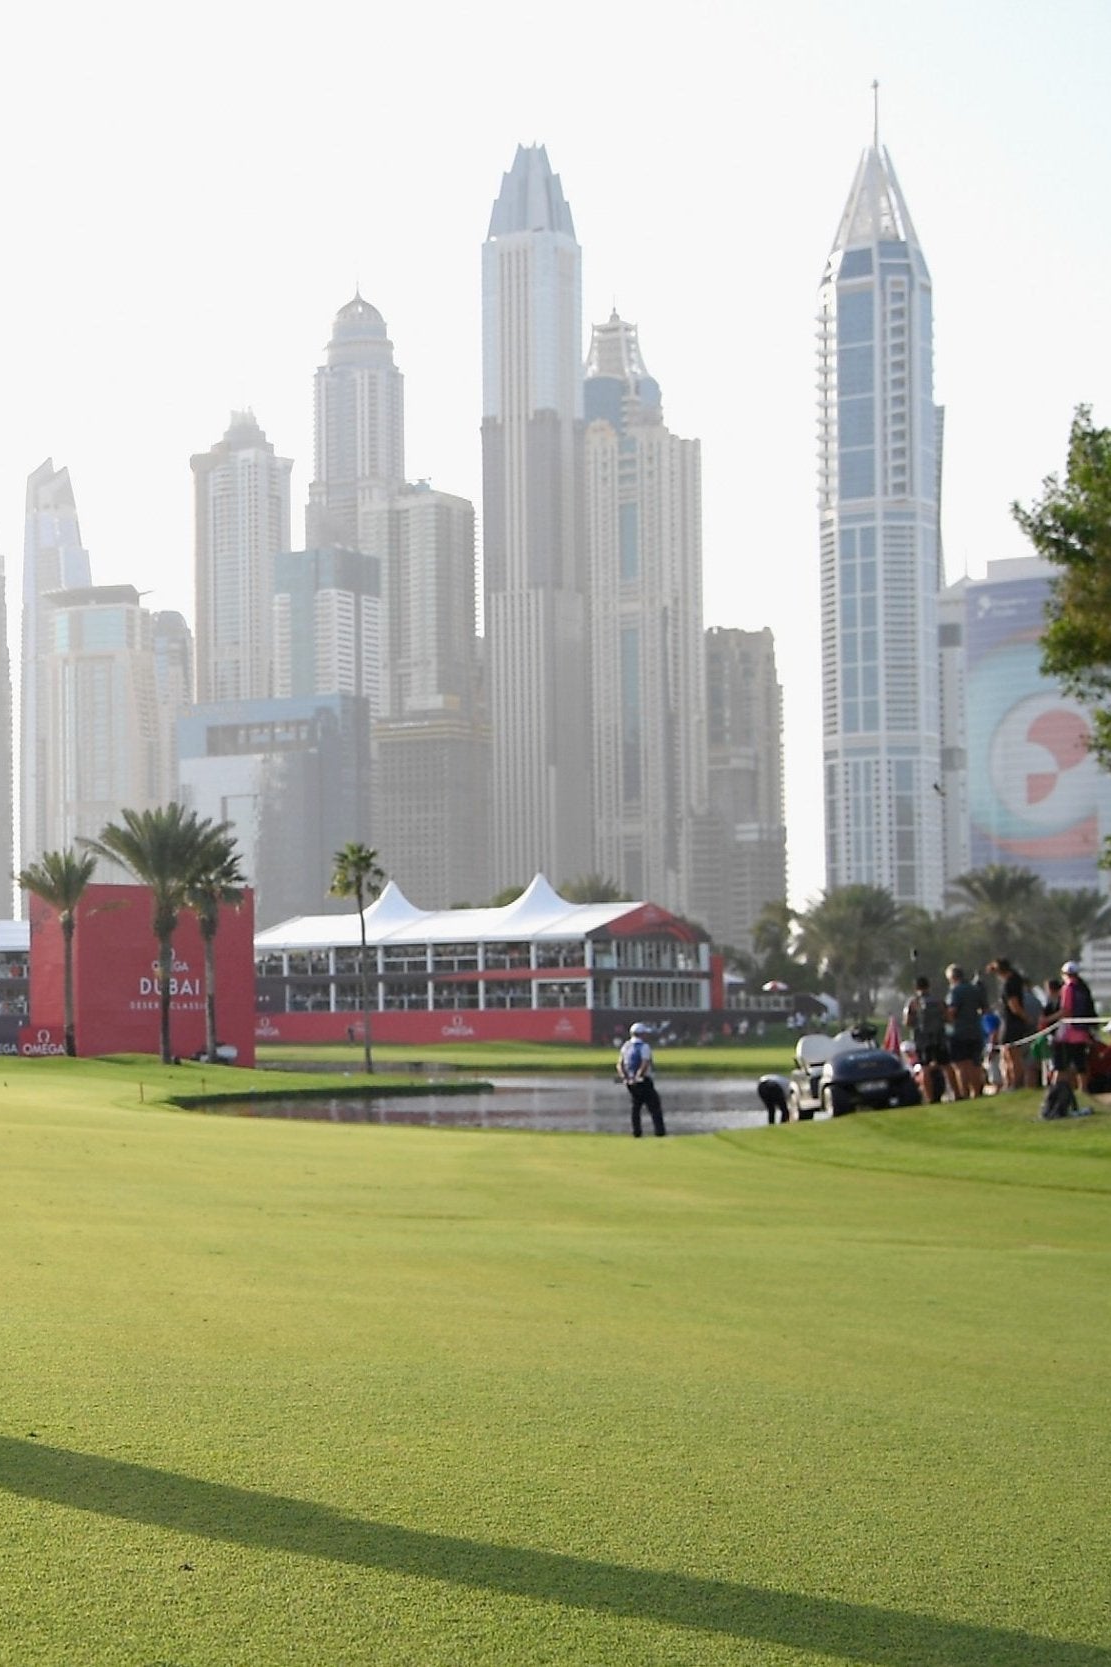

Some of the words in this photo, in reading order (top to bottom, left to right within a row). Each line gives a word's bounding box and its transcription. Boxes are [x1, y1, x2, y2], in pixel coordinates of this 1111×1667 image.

[152, 960, 189, 972] OGA
[140, 977, 200, 995] DUBAI
[129, 1001, 160, 1009] DESER
[441, 1026, 474, 1036] OMEGA
[23, 1043, 65, 1055] OMEGA
